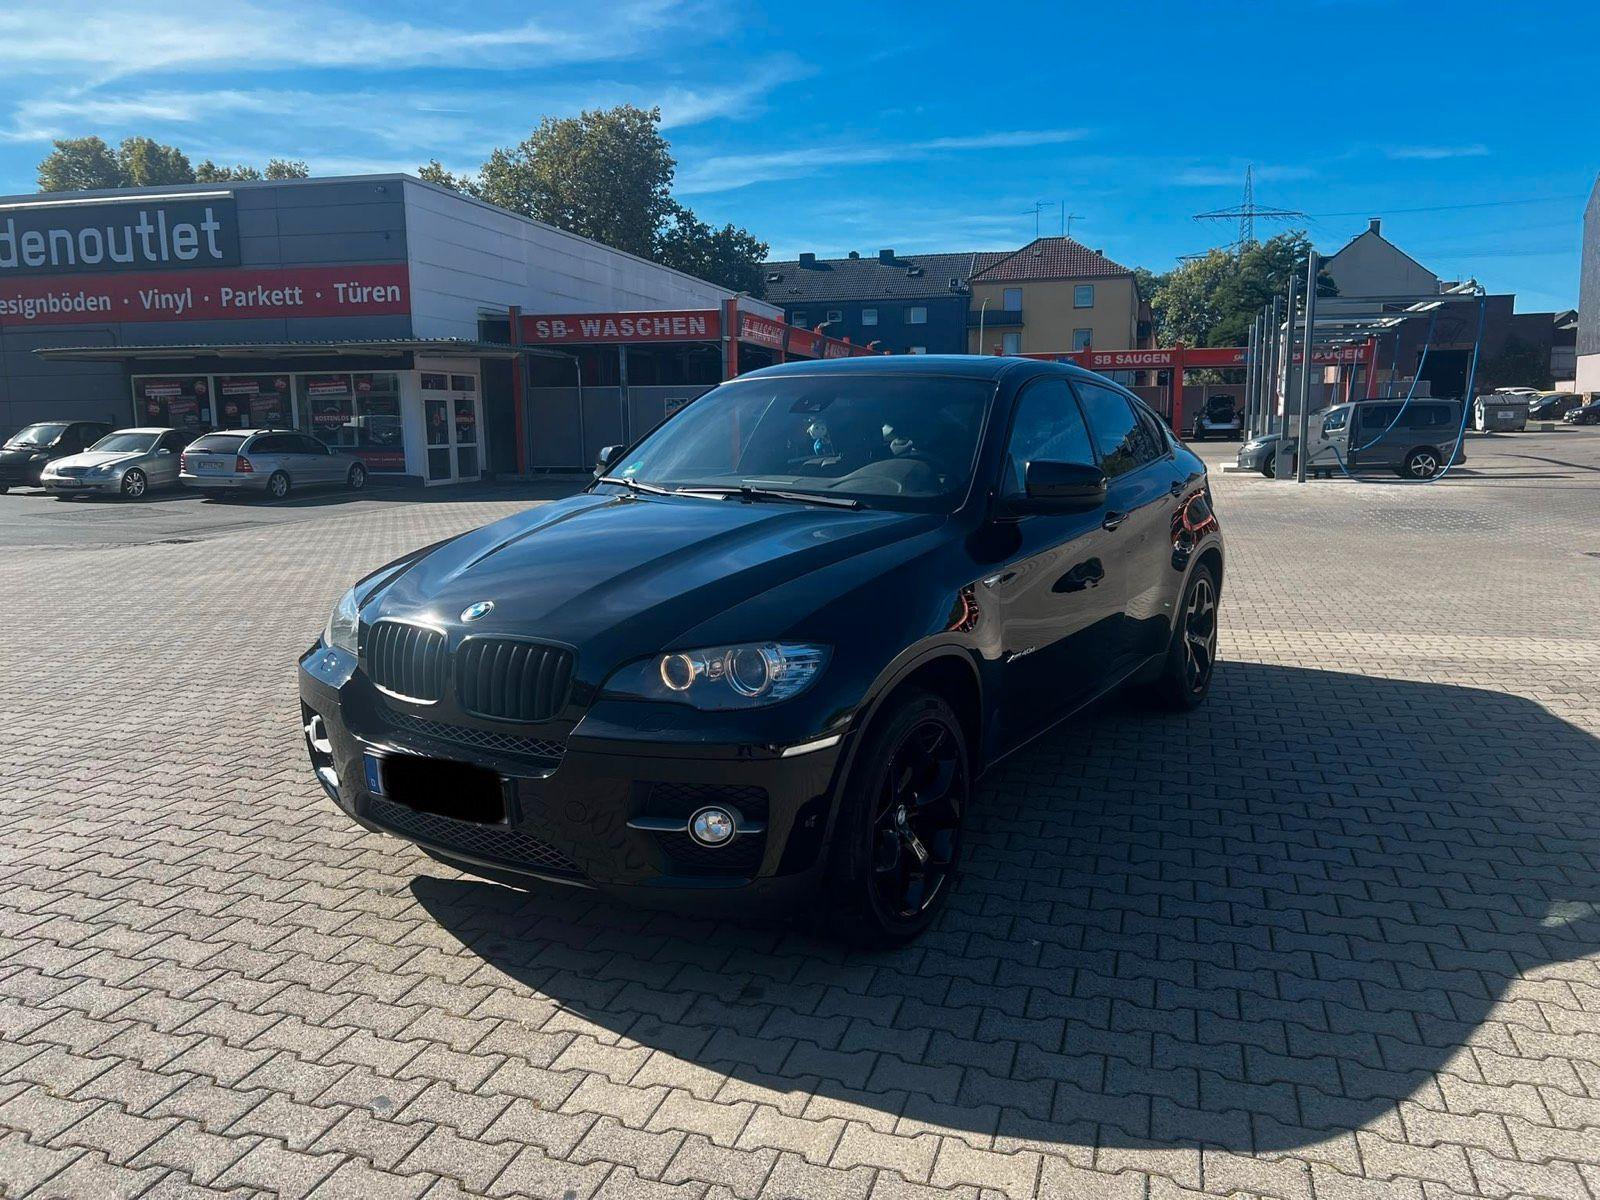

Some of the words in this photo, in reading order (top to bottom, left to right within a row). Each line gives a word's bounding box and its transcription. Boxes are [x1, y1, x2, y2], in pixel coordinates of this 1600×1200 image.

[138, 287, 193, 314] Vinyl
[221, 284, 303, 307] Parkett
[333, 280, 401, 304] Türen
[1094, 354, 1111, 365] SB
[1115, 353, 1170, 364] SAUGEN
[1312, 349, 1365, 360] AUGEN
